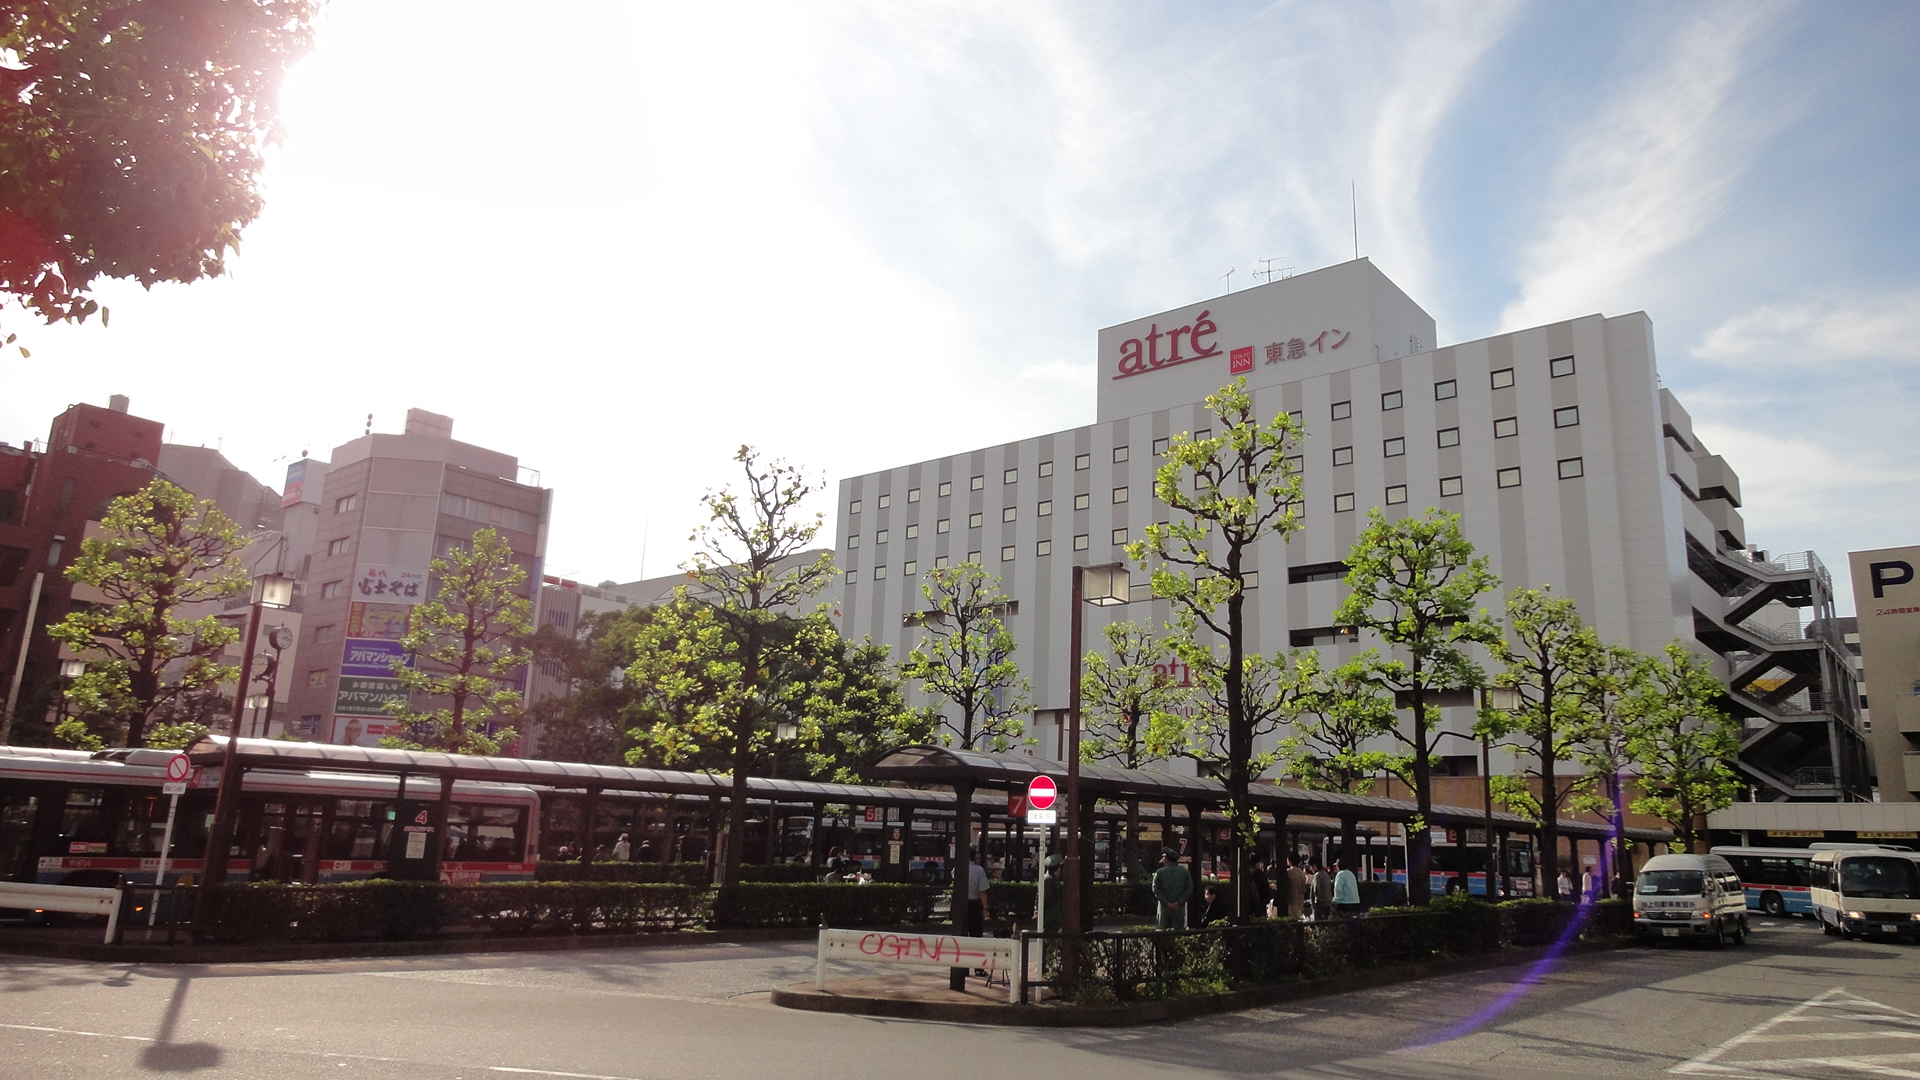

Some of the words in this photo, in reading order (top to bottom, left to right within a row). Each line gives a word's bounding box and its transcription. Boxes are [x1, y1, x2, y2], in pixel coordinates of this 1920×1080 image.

[1117, 309, 1218, 375] atré
[1263, 328, 1351, 366] 東急イン
[1232, 358, 1251, 369] INN
[1233, 351, 1251, 360] TOKYU
[358, 578, 423, 597] 富士そば
[1870, 560, 1914, 598] P
[1011, 795, 1024, 814] 7
[415, 809, 428, 825] 4
[866, 808, 875, 820] 5
[1179, 838, 1188, 854] 7
